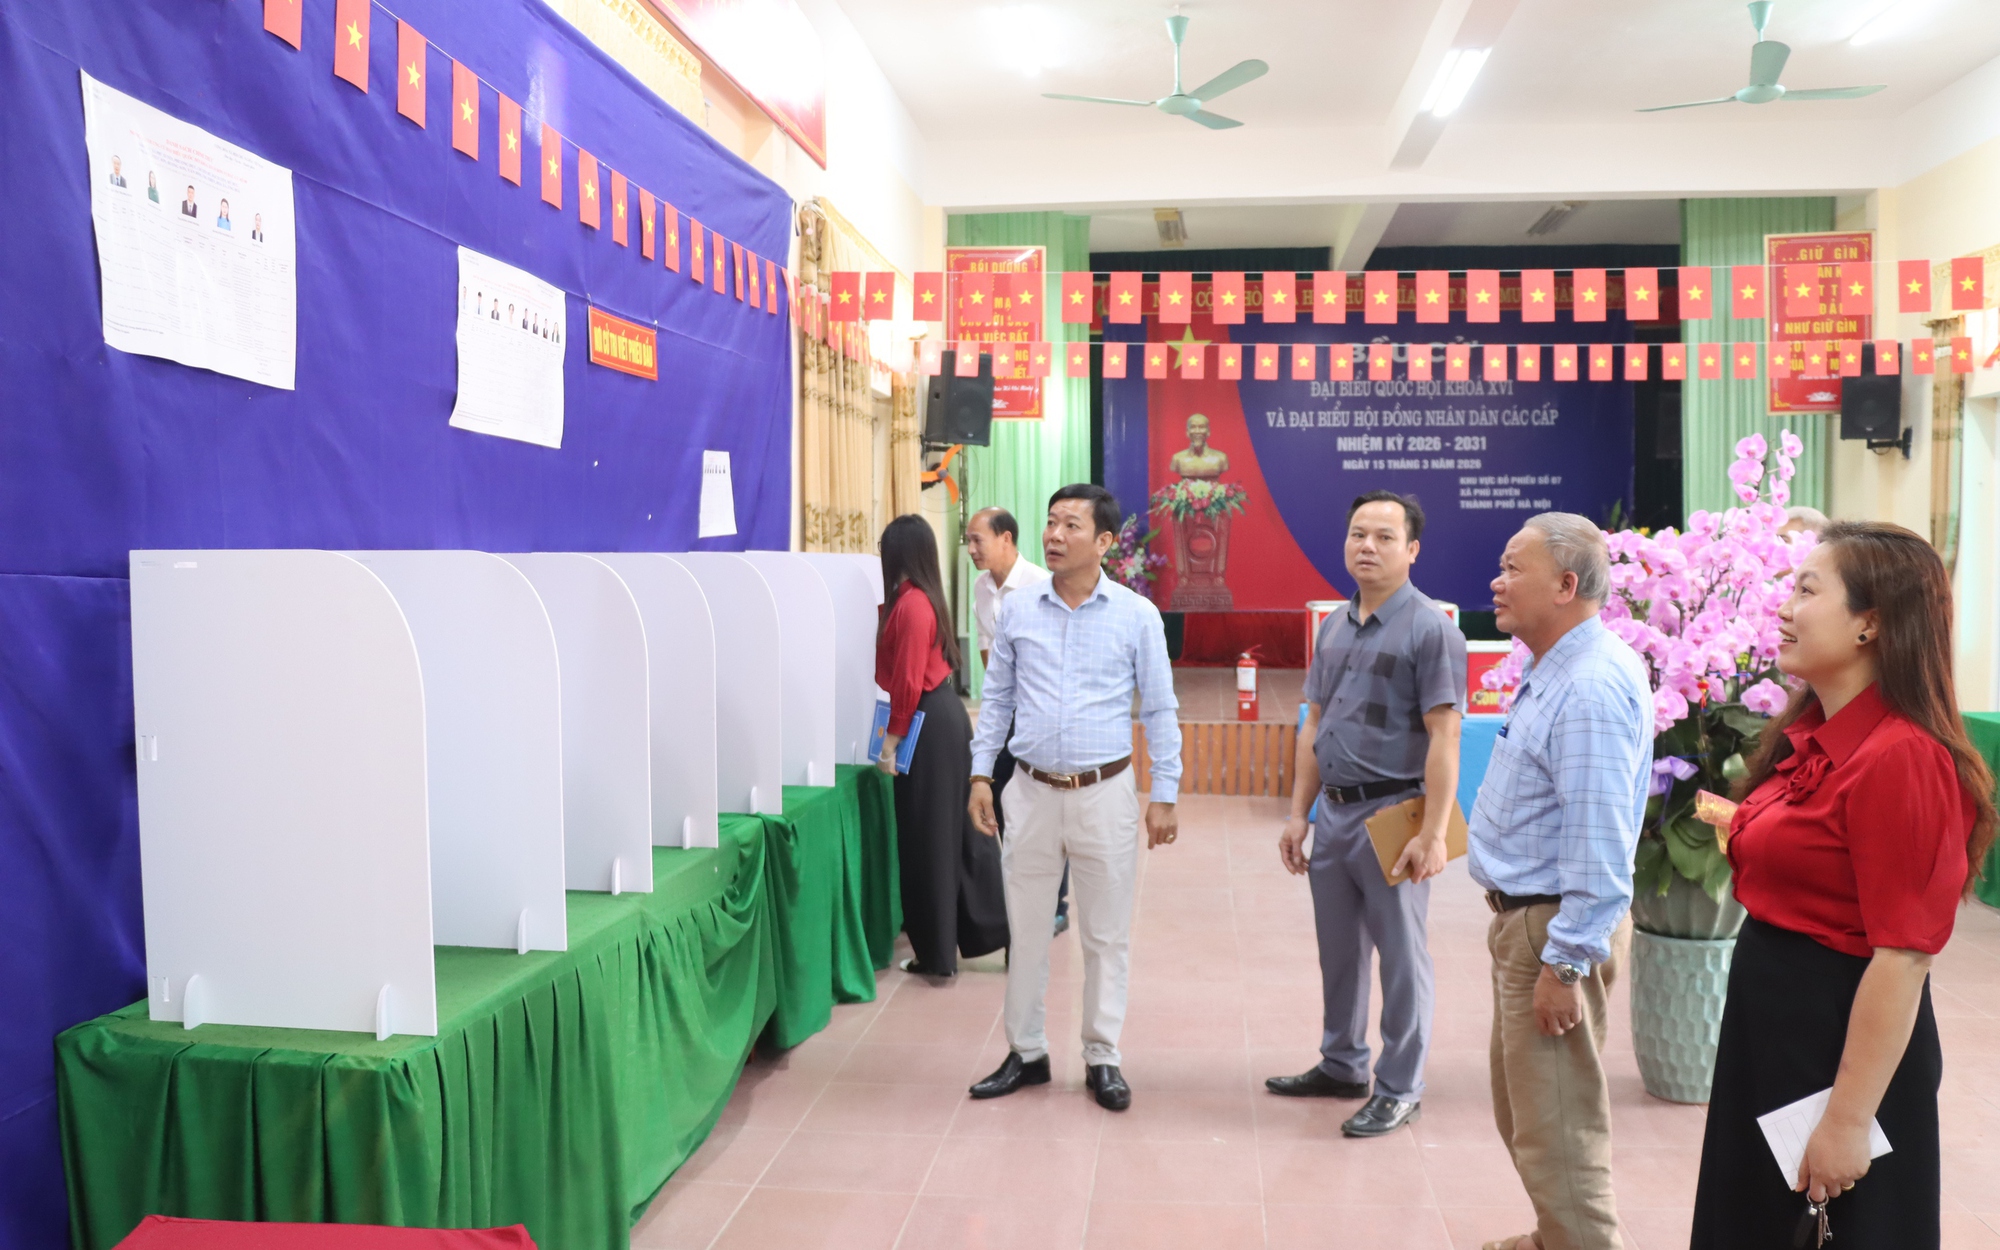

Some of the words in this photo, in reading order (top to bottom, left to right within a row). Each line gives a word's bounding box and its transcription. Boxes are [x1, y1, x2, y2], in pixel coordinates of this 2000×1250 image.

[1834, 246, 1858, 260] GÌN
[1785, 321, 1811, 334] NHƯ
[1813, 317, 1835, 334] GIỮ
[1836, 318, 1857, 333] GÌN
[1310, 381, 1336, 401] ĐẠI
[1340, 370, 1371, 397] BIỂU
[1375, 372, 1413, 398] QUỐC
[1416, 376, 1441, 400] HỘI
[1487, 379, 1514, 396] XVI
[1266, 407, 1287, 428] VÀ
[1289, 411, 1315, 431] ĐẠI
[1318, 400, 1350, 428] BIỂU
[1354, 405, 1379, 431] HỘI
[1382, 402, 1422, 427] ĐỒNG
[1425, 405, 1466, 427] NHÂN
[1469, 404, 1500, 426] DÂN
[1502, 404, 1529, 426] CÁC
[1531, 402, 1559, 426] CẤP
[1337, 434, 1382, 454] NHIỆM
[1386, 433, 1404, 451] KỲ
[1407, 436, 1442, 451] 2026
[1454, 436, 1487, 451] 2031
[1343, 458, 1370, 470] NGÀY
[1373, 459, 1385, 470] 15
[1387, 458, 1420, 470] THÁNG
[1422, 459, 1429, 470] 3
[1431, 458, 1455, 470] NĂM
[1457, 459, 1482, 470] 2026
[1460, 476, 1477, 485] KHU
[1478, 476, 1495, 486] VỰC
[1511, 474, 1536, 485] PHIẾU
[1538, 474, 1550, 485] SỐ
[1493, 487, 1521, 497] XUYÊN
[1460, 499, 1493, 509] THÀNH
[1495, 498, 1516, 509] PHỐ
[1517, 498, 1531, 509] HÀ
[1533, 498, 1552, 510] NỘI
